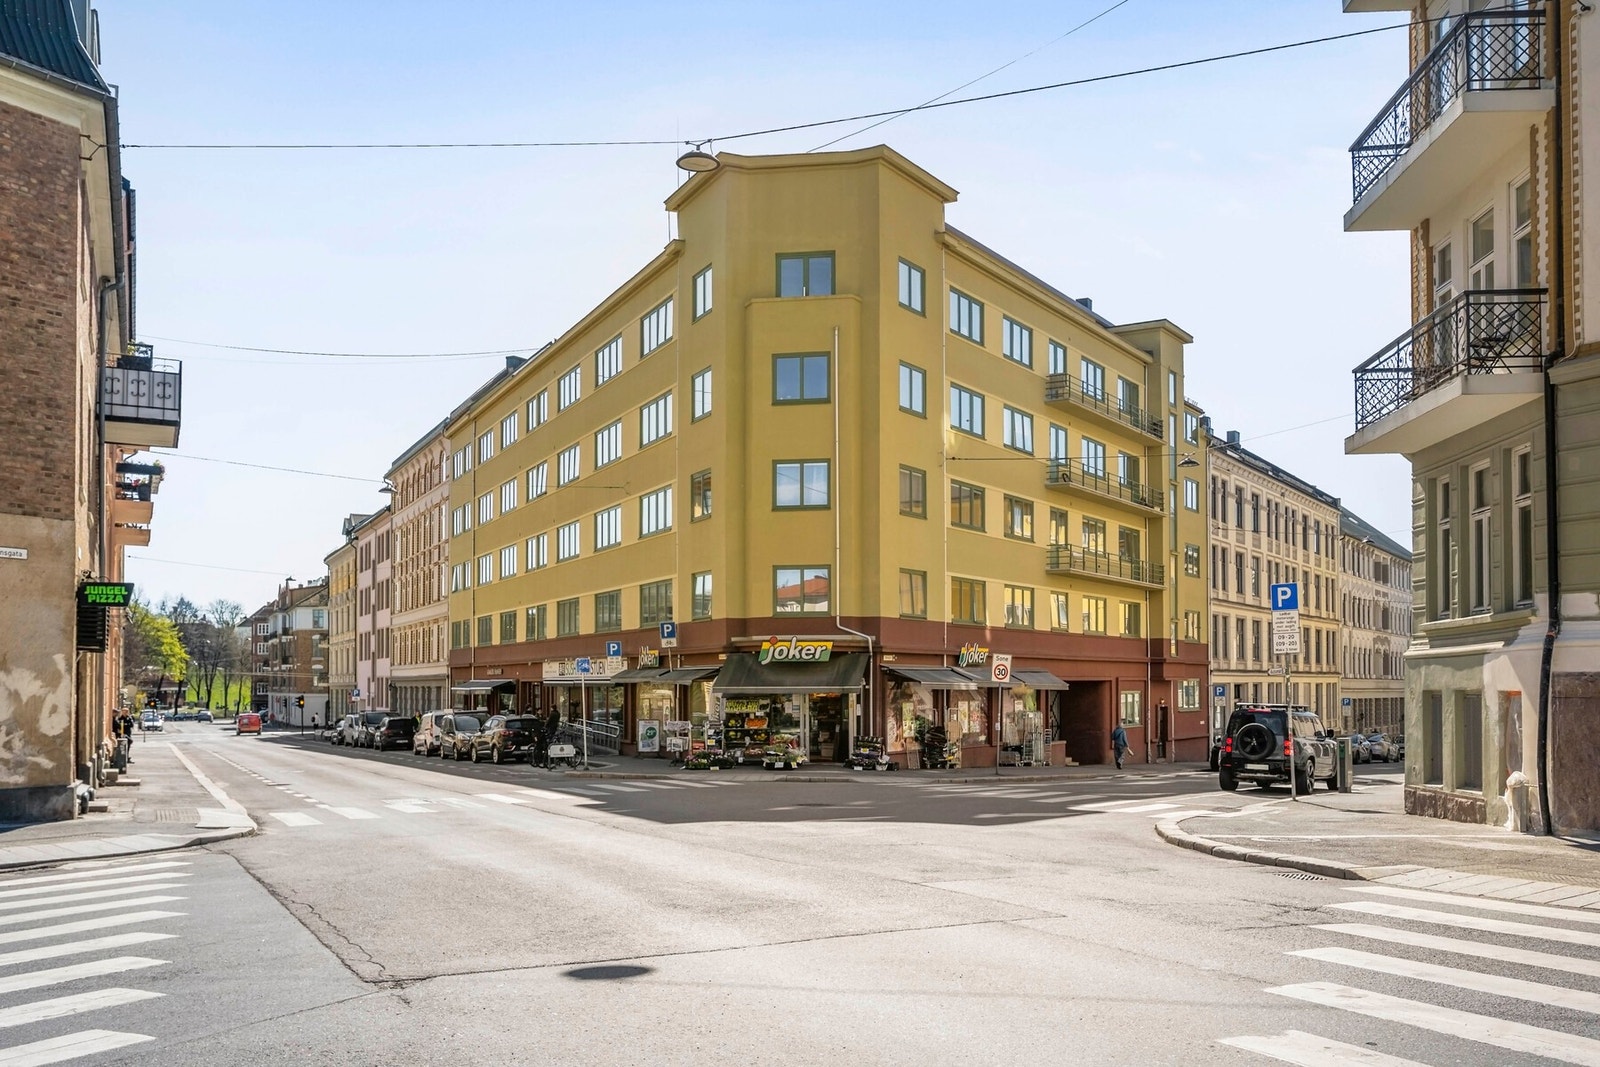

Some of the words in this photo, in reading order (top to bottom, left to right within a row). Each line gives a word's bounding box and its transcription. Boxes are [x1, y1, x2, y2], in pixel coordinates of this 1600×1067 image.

[84, 585, 128, 595] JUNGEL
[88, 594, 124, 603] PIZZA
[1277, 586, 1292, 608] P
[664, 624, 672, 637] P
[610, 643, 617, 655] P
[761, 635, 827, 665] joker
[996, 667, 1006, 677] 30
[1216, 686, 1223, 696] P
